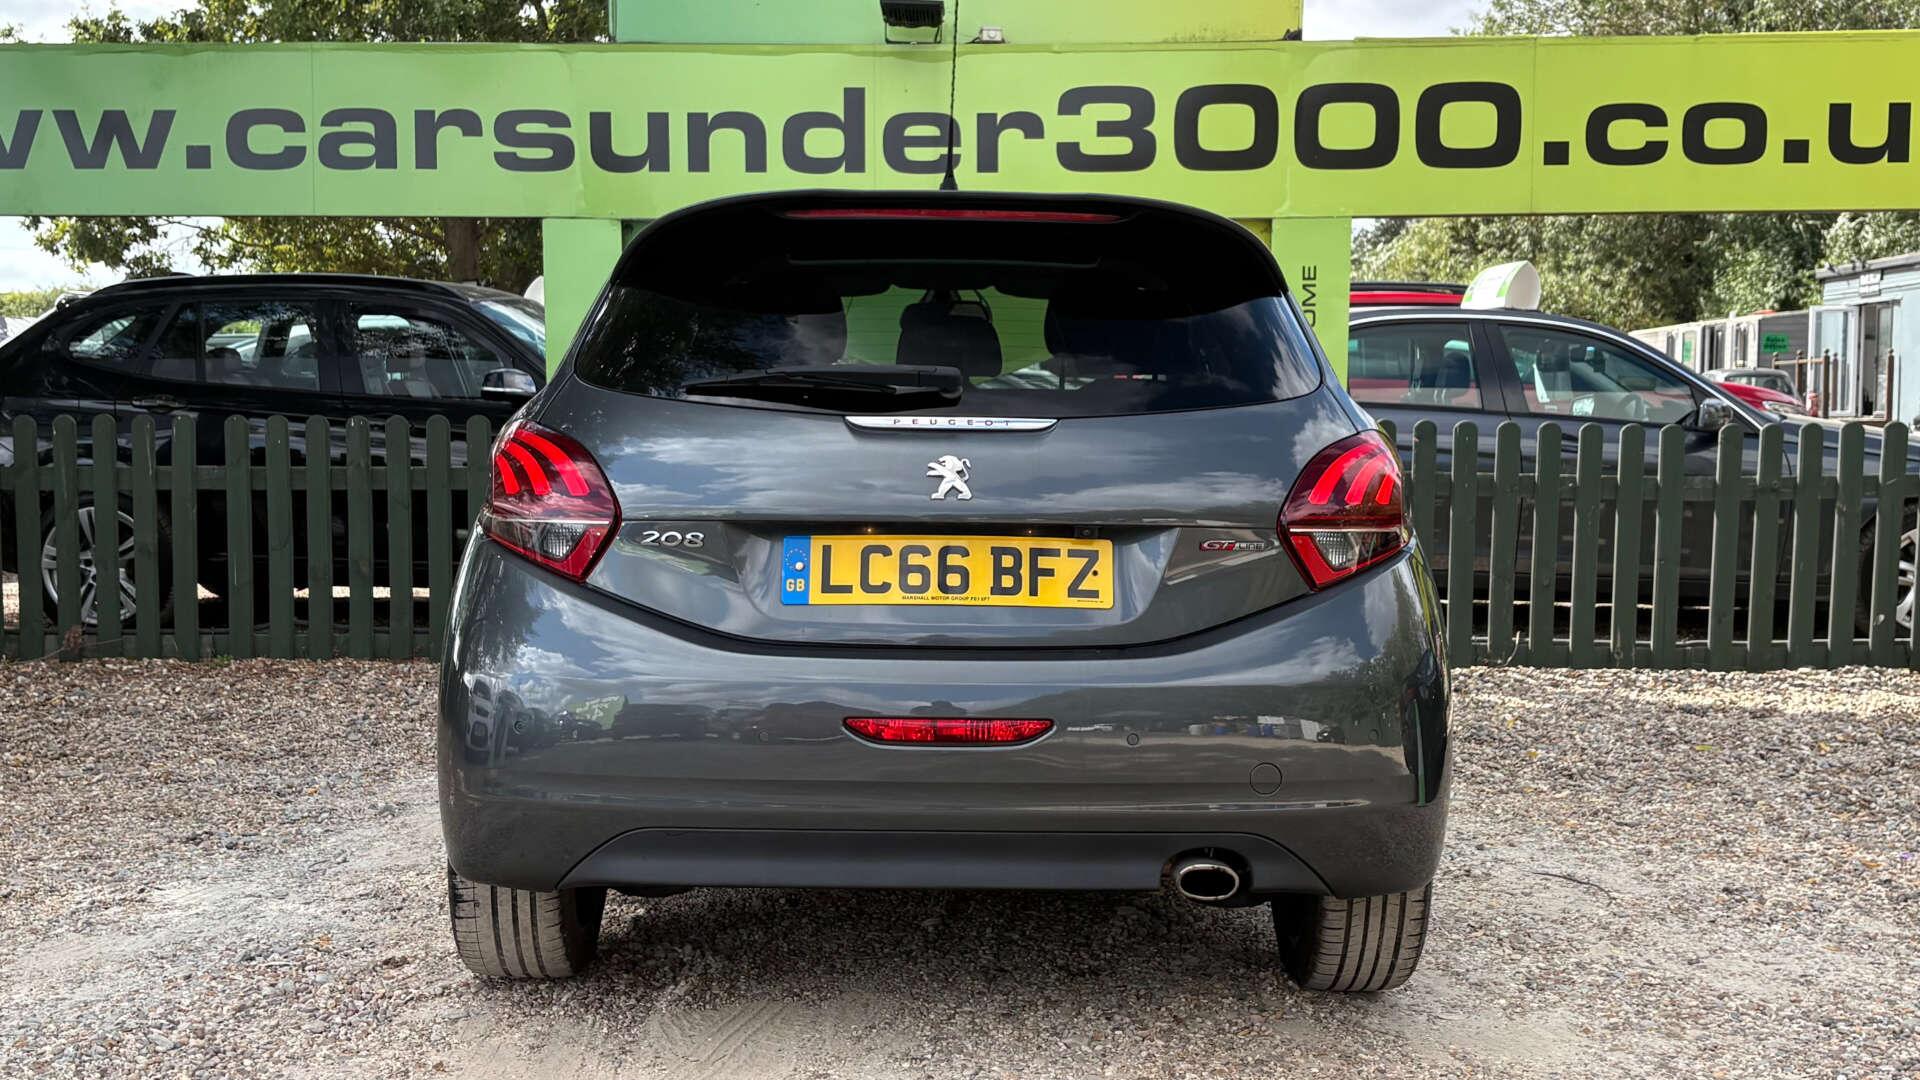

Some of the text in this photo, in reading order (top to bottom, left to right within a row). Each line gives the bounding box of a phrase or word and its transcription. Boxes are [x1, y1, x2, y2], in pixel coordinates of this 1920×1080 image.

[893, 418, 1010, 427] PEUGEOT
[641, 530, 705, 548] 208
[821, 544, 1100, 599] LC66 BFZ
[785, 578, 805, 592] GB
